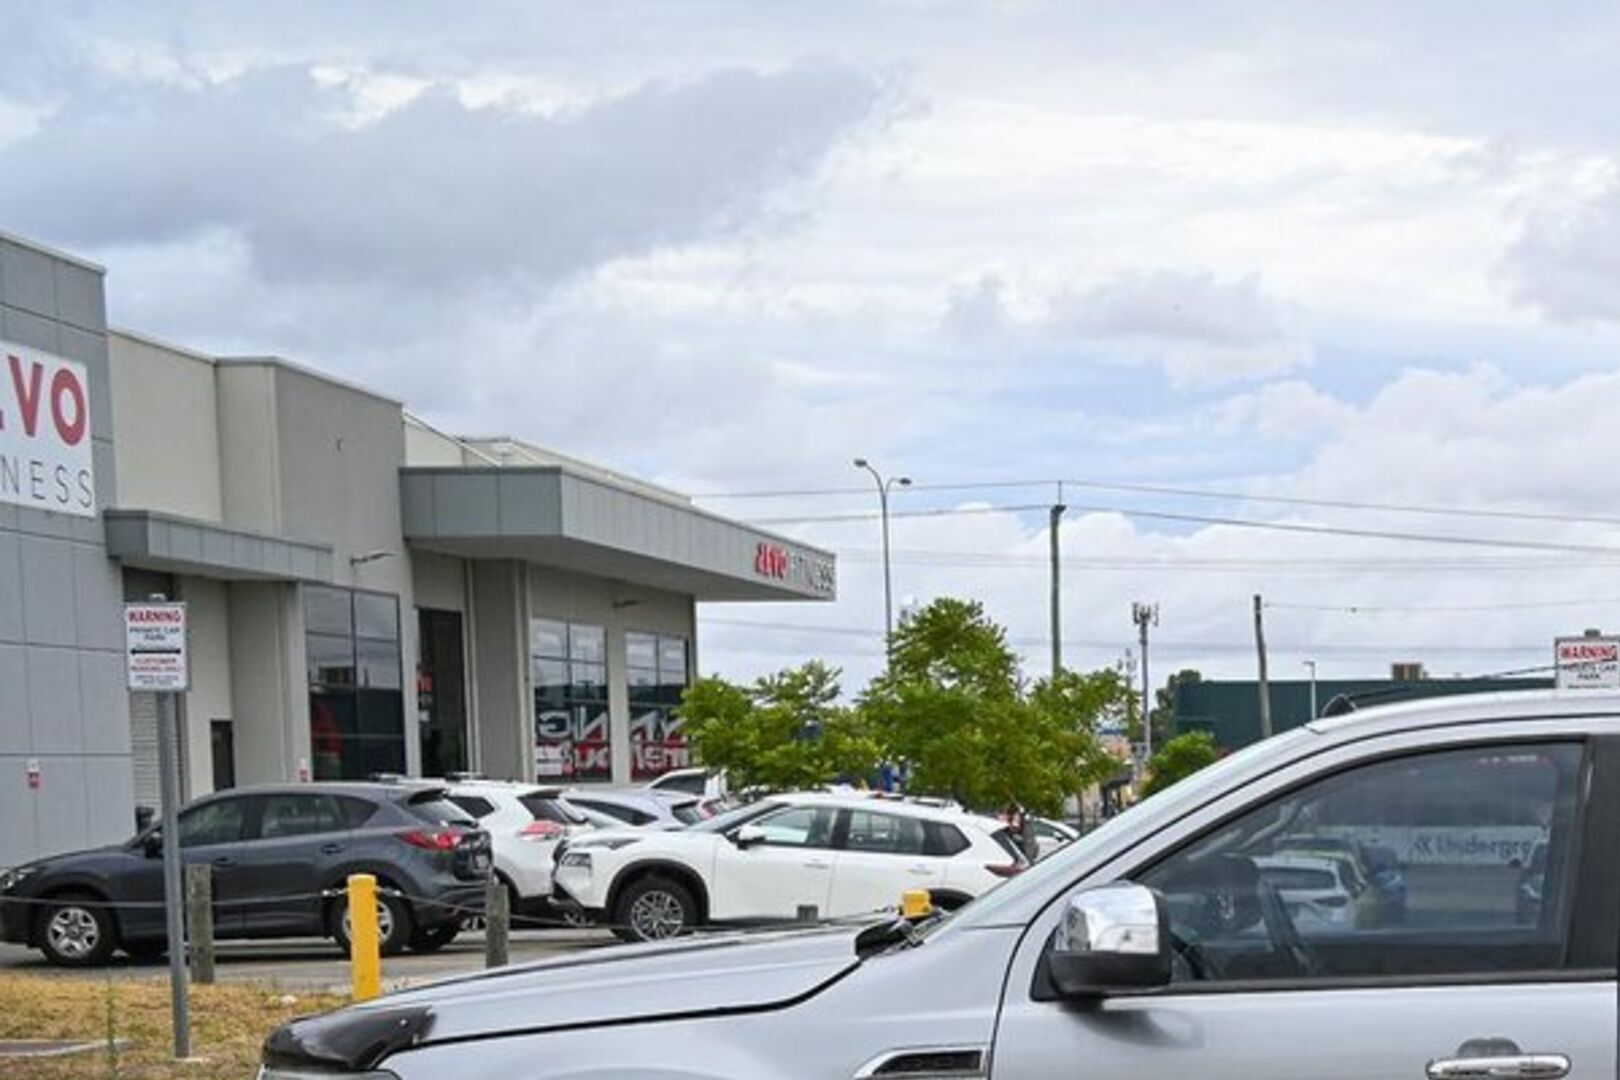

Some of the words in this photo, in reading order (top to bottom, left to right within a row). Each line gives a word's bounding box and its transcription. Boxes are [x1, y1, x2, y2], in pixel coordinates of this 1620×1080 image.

[0, 355, 86, 446] VO
[128, 609, 181, 623] WARNING
[1560, 645, 1618, 660] WARNING
